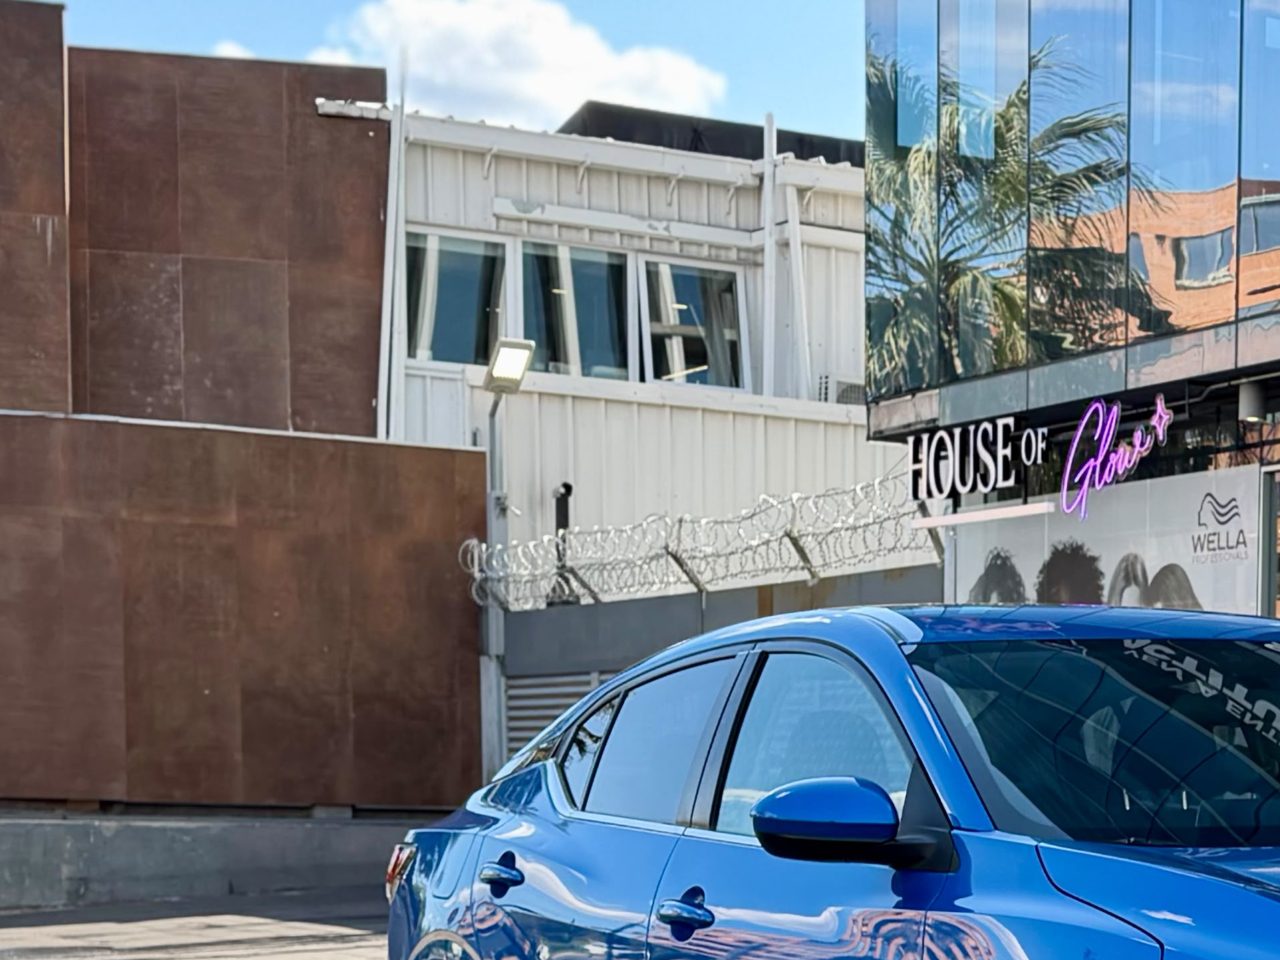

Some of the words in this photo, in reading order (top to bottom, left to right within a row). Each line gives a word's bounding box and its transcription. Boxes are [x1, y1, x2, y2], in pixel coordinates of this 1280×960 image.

[907, 416, 1016, 501] HOUSE
[1021, 428, 1048, 467] OF
[1191, 529, 1247, 554] WELLA
